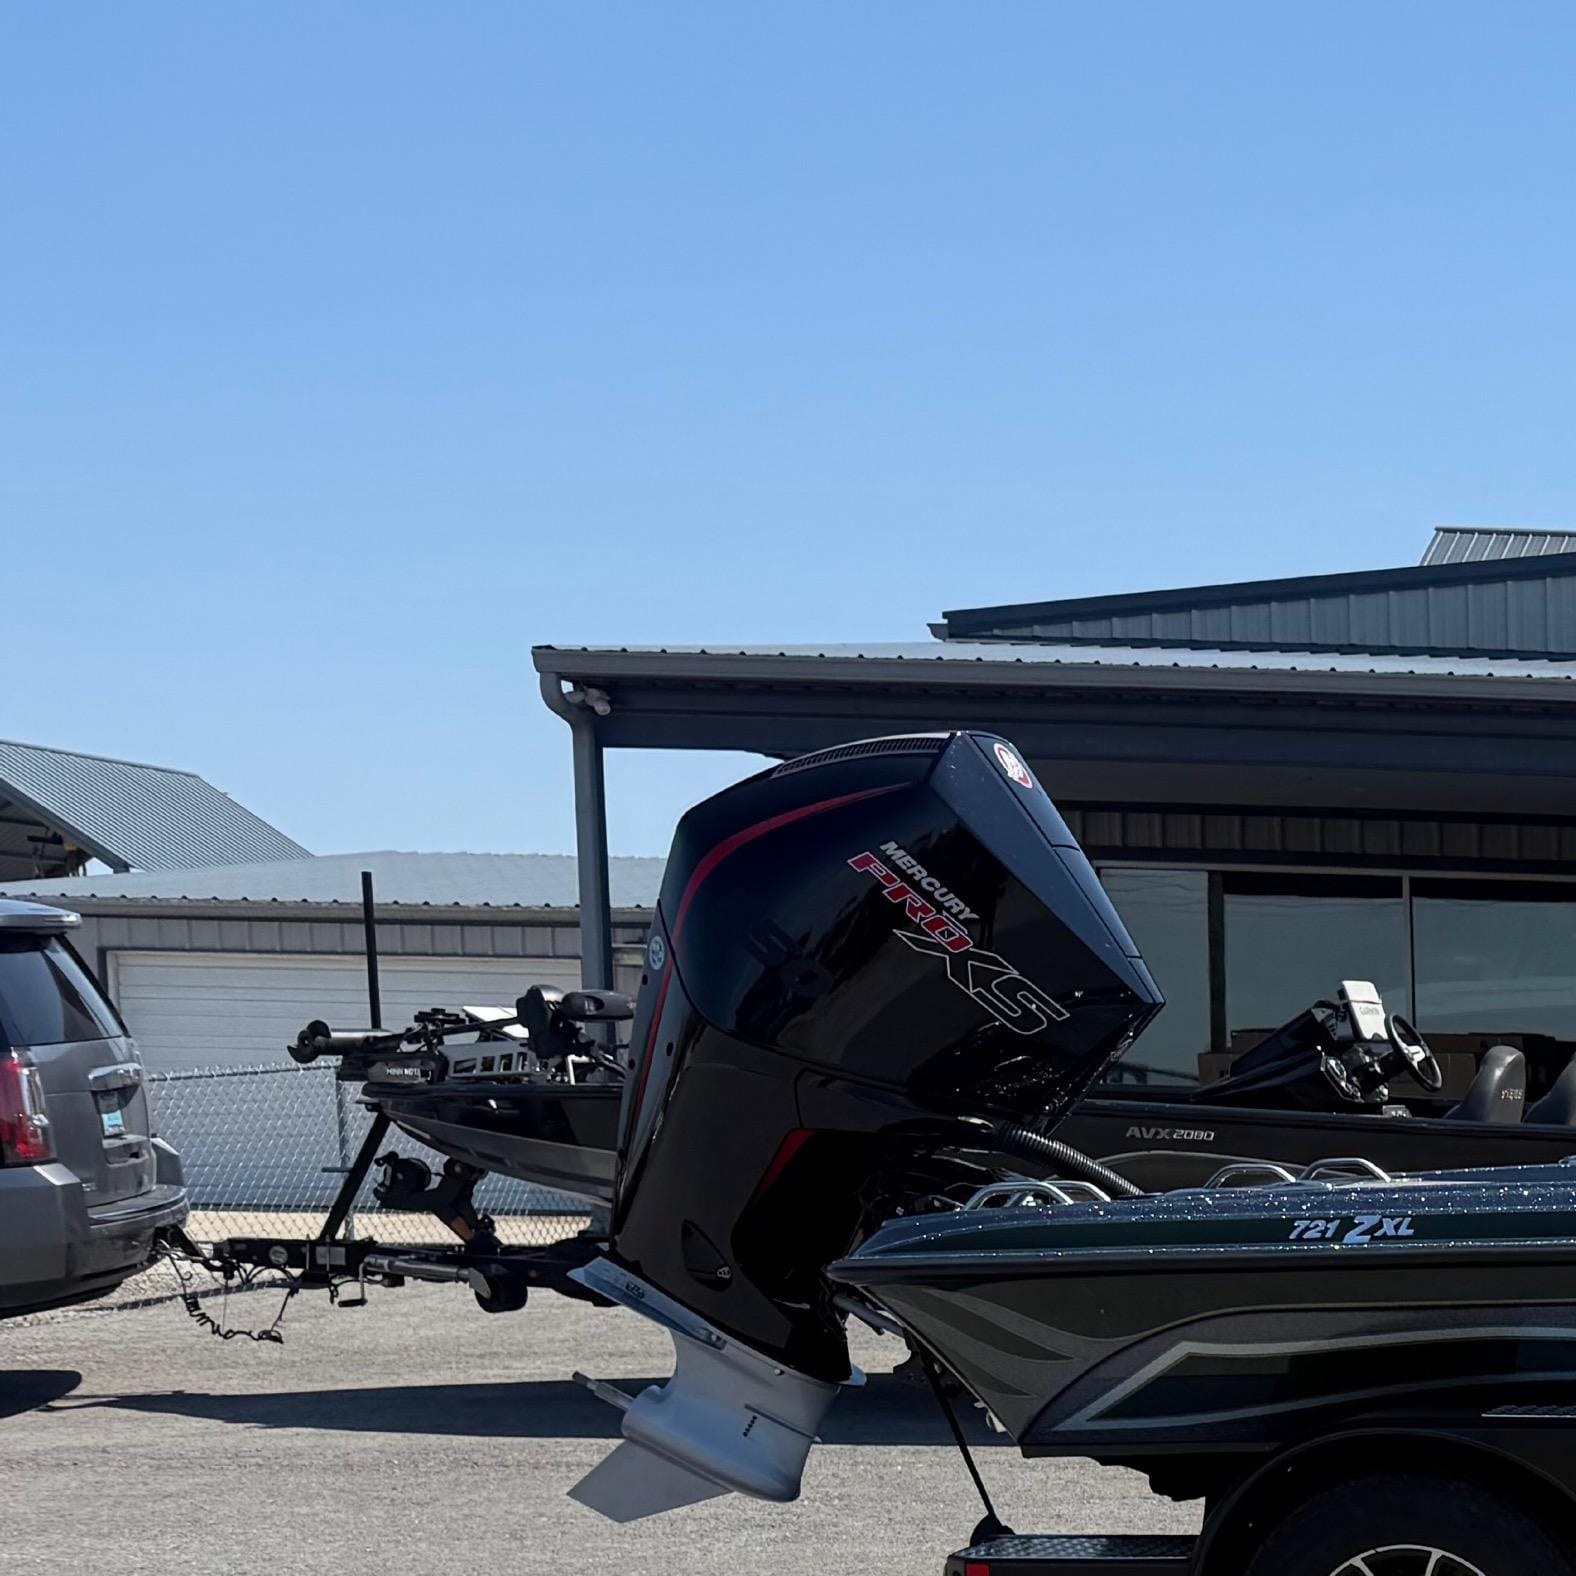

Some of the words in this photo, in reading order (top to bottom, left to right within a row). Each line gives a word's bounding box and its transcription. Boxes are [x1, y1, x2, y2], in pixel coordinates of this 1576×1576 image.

[847, 851, 974, 953] PRO
[880, 840, 980, 921] MERCURY
[893, 927, 1071, 1035] XS
[1288, 1219, 1341, 1240] 721
